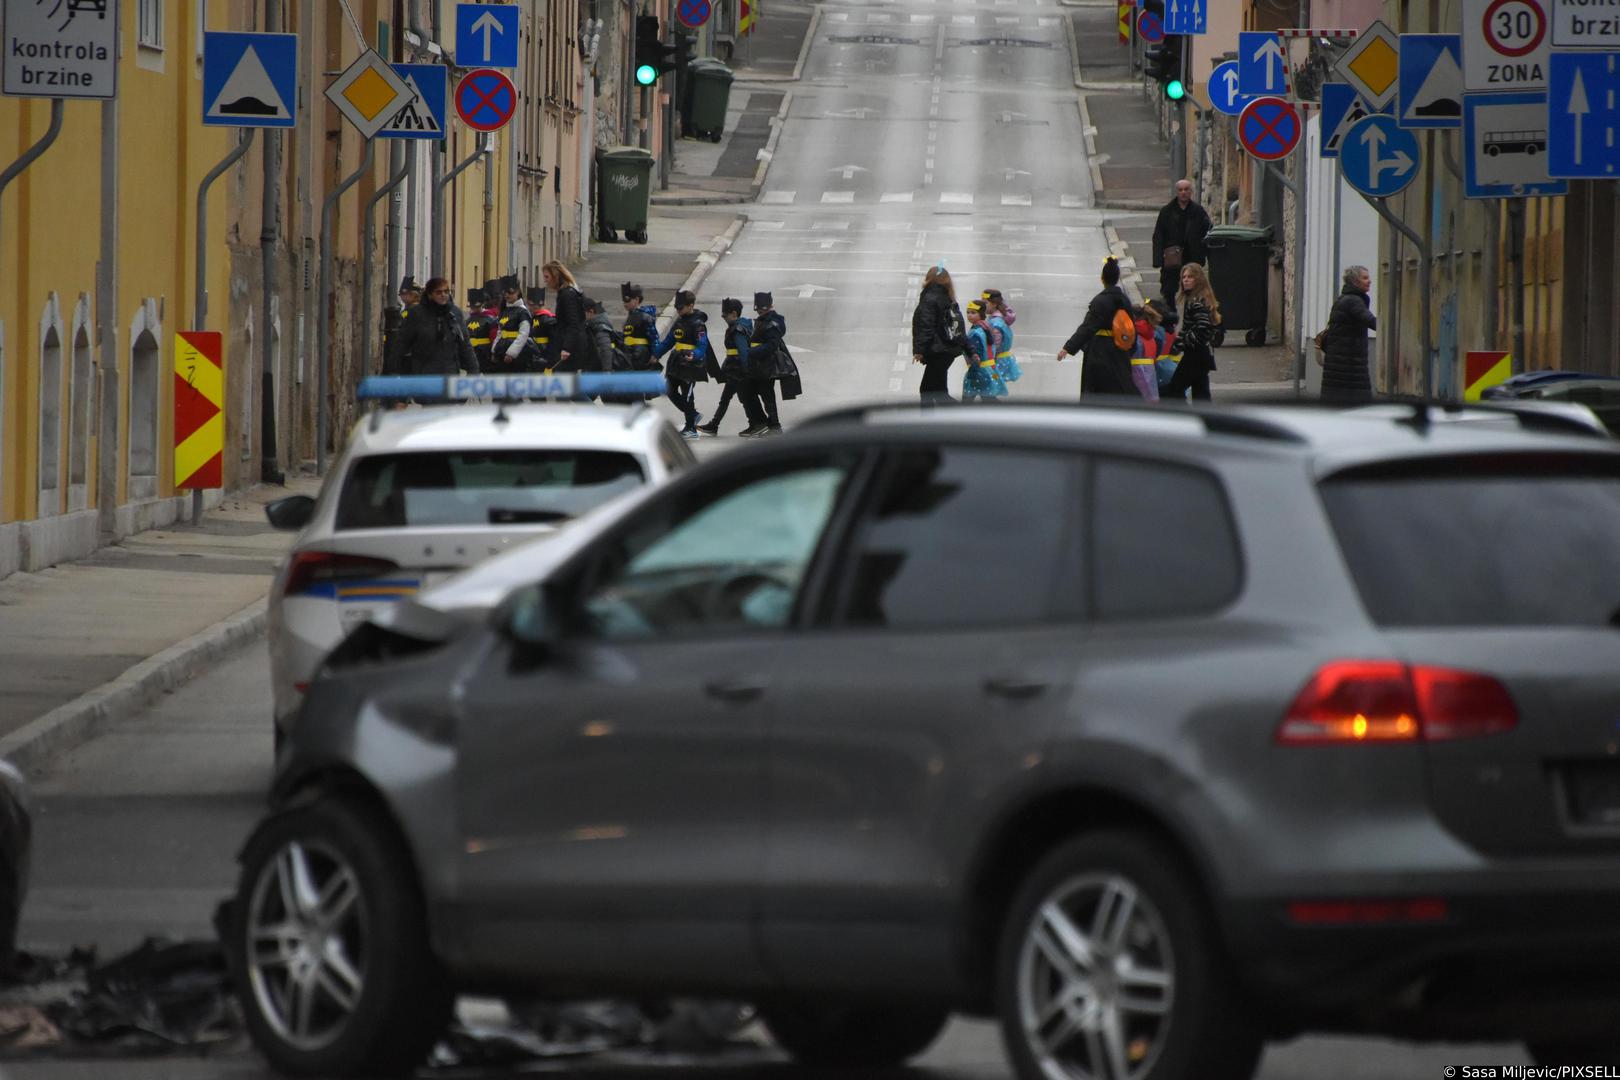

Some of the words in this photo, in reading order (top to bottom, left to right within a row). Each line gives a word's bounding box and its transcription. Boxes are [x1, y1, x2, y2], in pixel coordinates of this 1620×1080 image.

[1497, 11, 1531, 39] 30
[13, 37, 107, 60] kontrola
[22, 65, 93, 86] brzine
[1487, 64, 1544, 82] ZONA
[456, 377, 565, 398] POLICIJA
